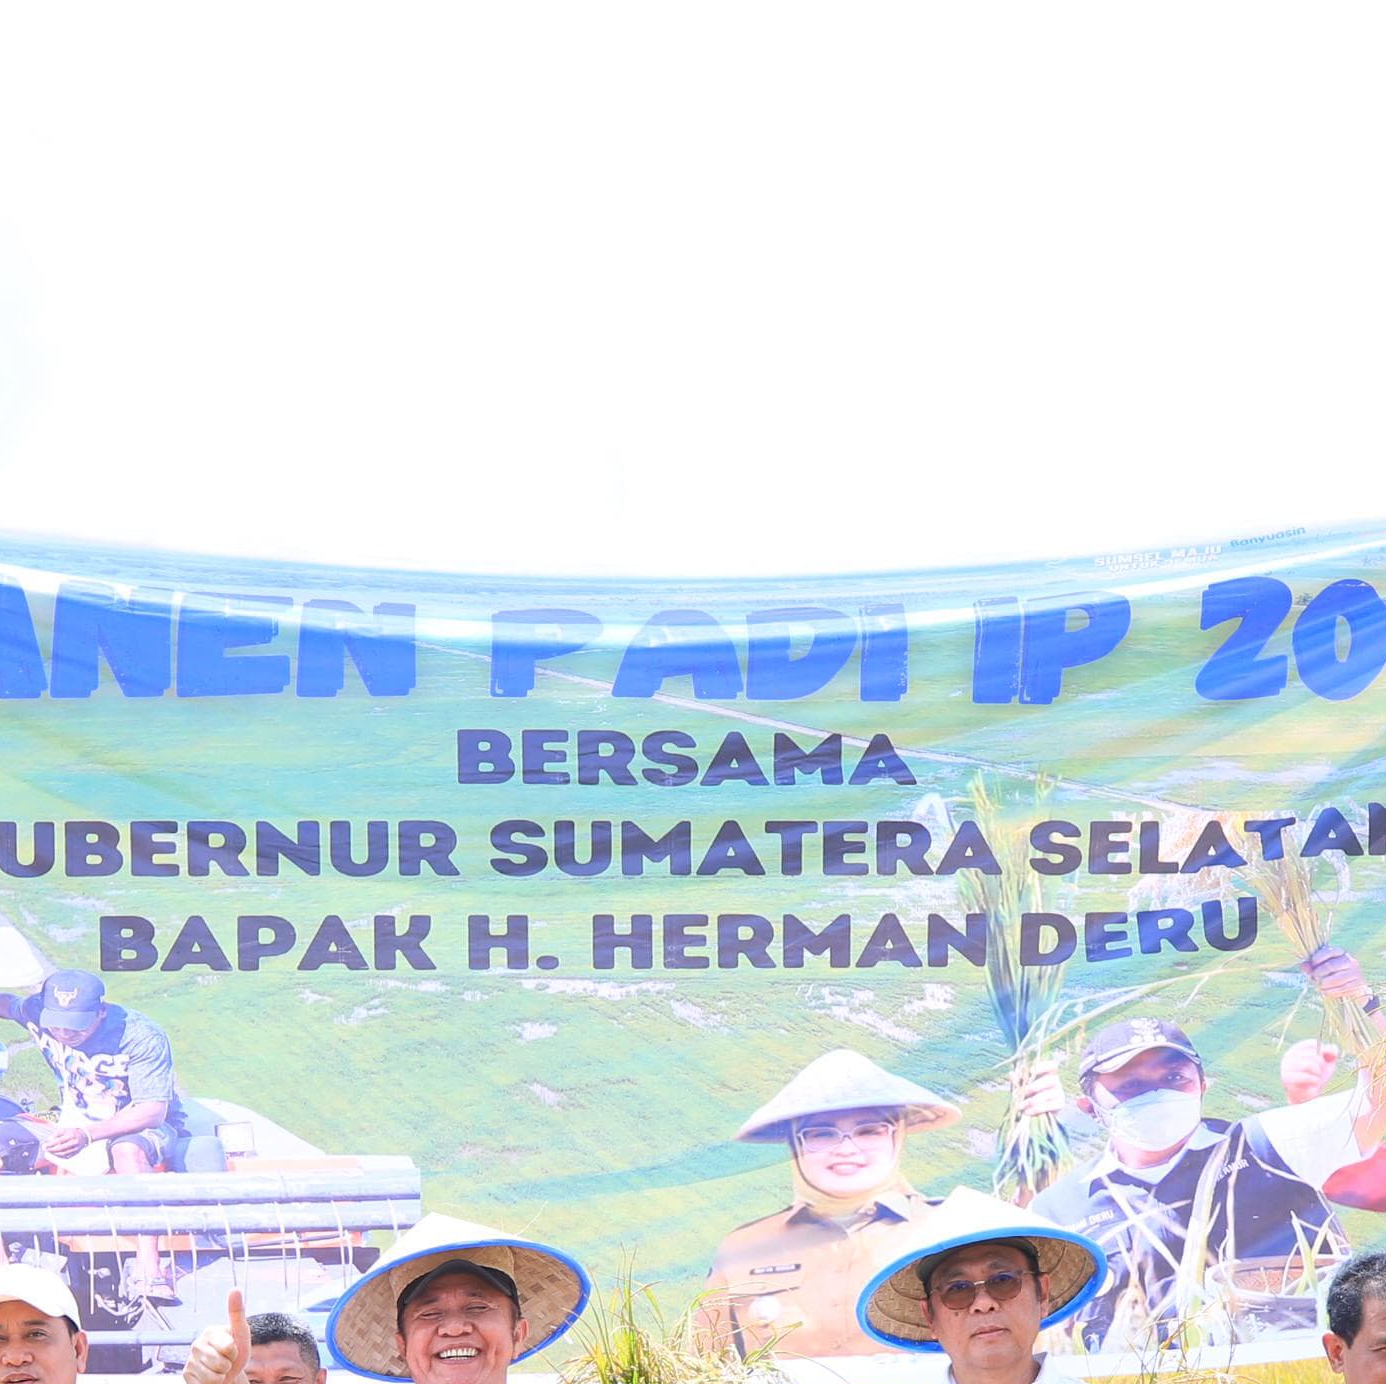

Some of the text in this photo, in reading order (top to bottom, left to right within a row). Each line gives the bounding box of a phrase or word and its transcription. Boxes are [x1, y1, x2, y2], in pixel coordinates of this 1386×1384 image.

[490, 601, 909, 702] PADI
[972, 590, 1132, 704] IP
[457, 729, 917, 786] BERSAMA
[489, 819, 1002, 878] SUMATERA
[99, 897, 1258, 972] BAPAK H. HERMAN DERU
